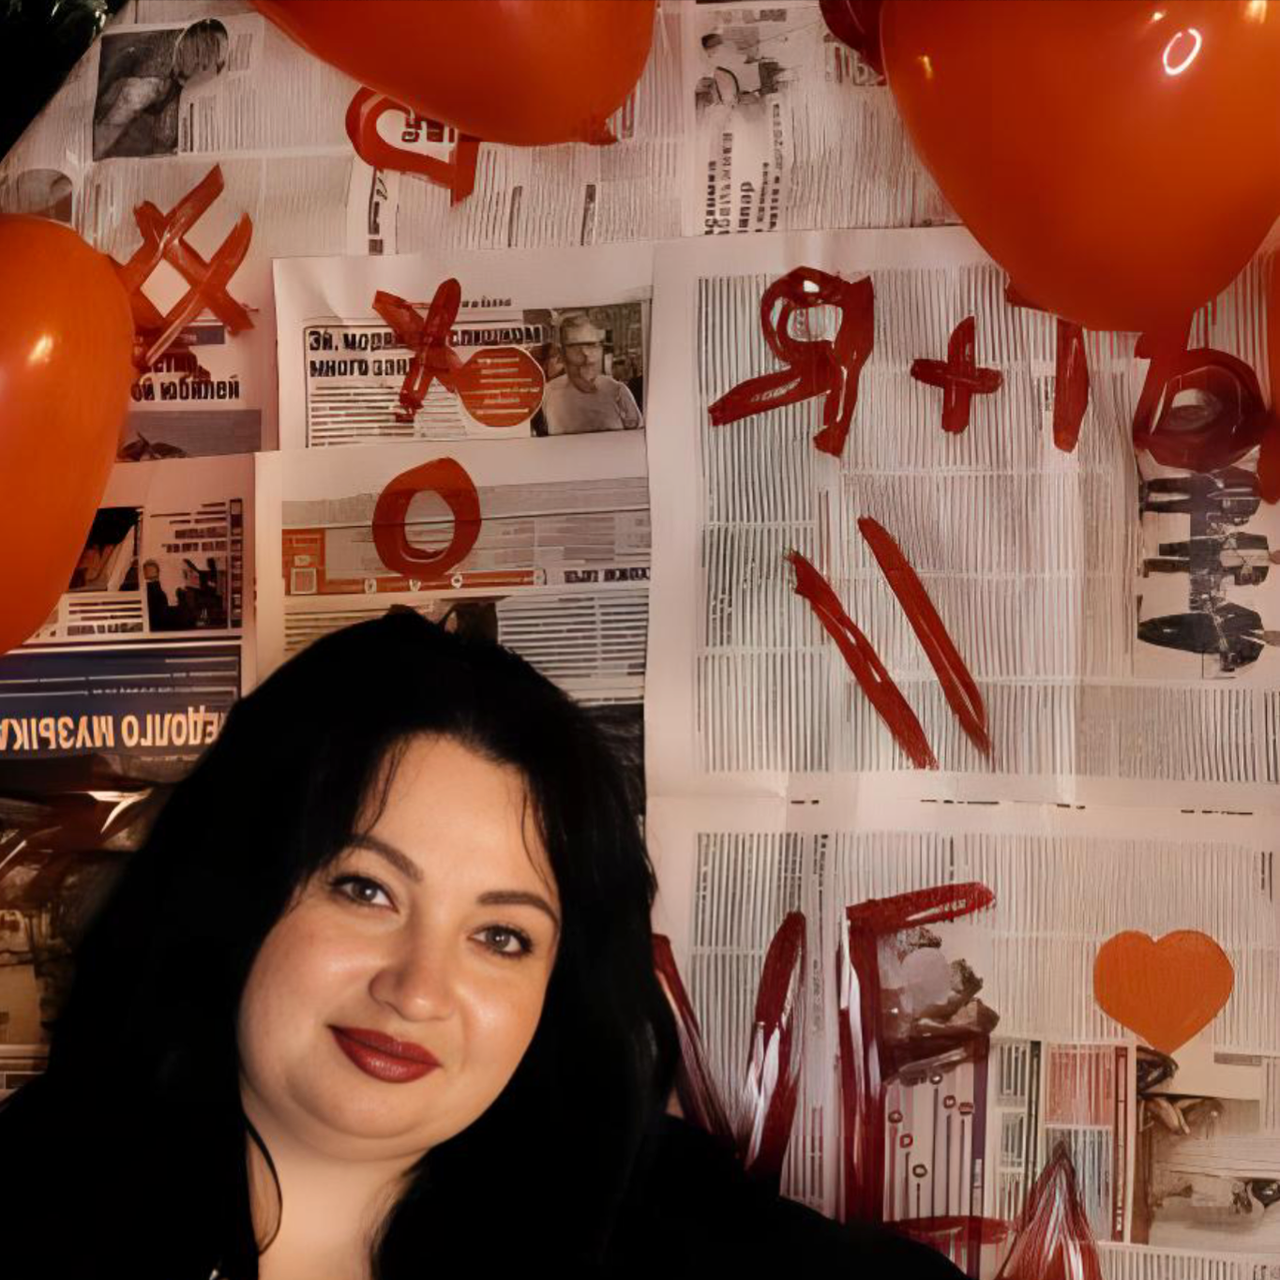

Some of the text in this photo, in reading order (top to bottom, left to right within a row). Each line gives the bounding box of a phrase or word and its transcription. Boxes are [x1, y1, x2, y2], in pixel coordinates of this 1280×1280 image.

[309, 359, 369, 378] много
[159, 373, 240, 401] юбилей
[120, 705, 228, 749] ЕДОЛГО
